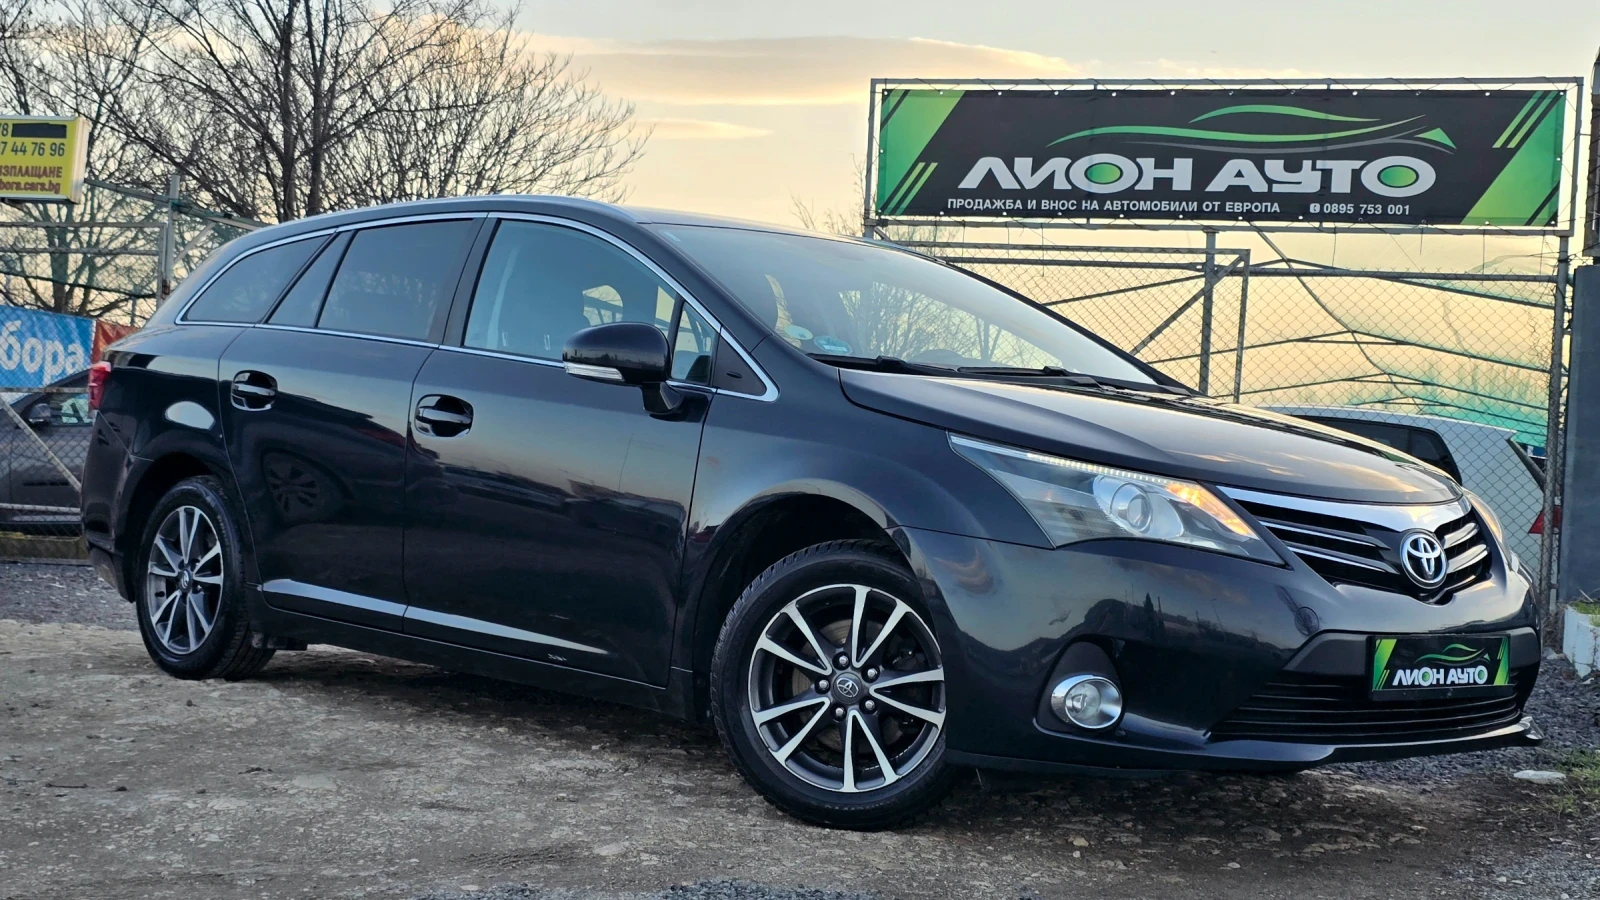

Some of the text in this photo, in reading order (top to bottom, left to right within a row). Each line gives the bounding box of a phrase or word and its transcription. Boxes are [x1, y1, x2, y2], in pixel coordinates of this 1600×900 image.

[0, 123, 9, 137] 8
[11, 141, 27, 156] 44
[31, 142, 46, 157] 76
[49, 142, 66, 157] 96
[957, 153, 1437, 198] ЛИОН АУТО
[947, 198, 1281, 213] ПРОДАЖБА И ВНОС НА АВТОМОБИЛИ ОТ ЕВРОПА
[1323, 203, 1410, 215] 0895 753 001
[0, 320, 85, 387] бора
[1392, 665, 1488, 687] ЛИОН АУТО
